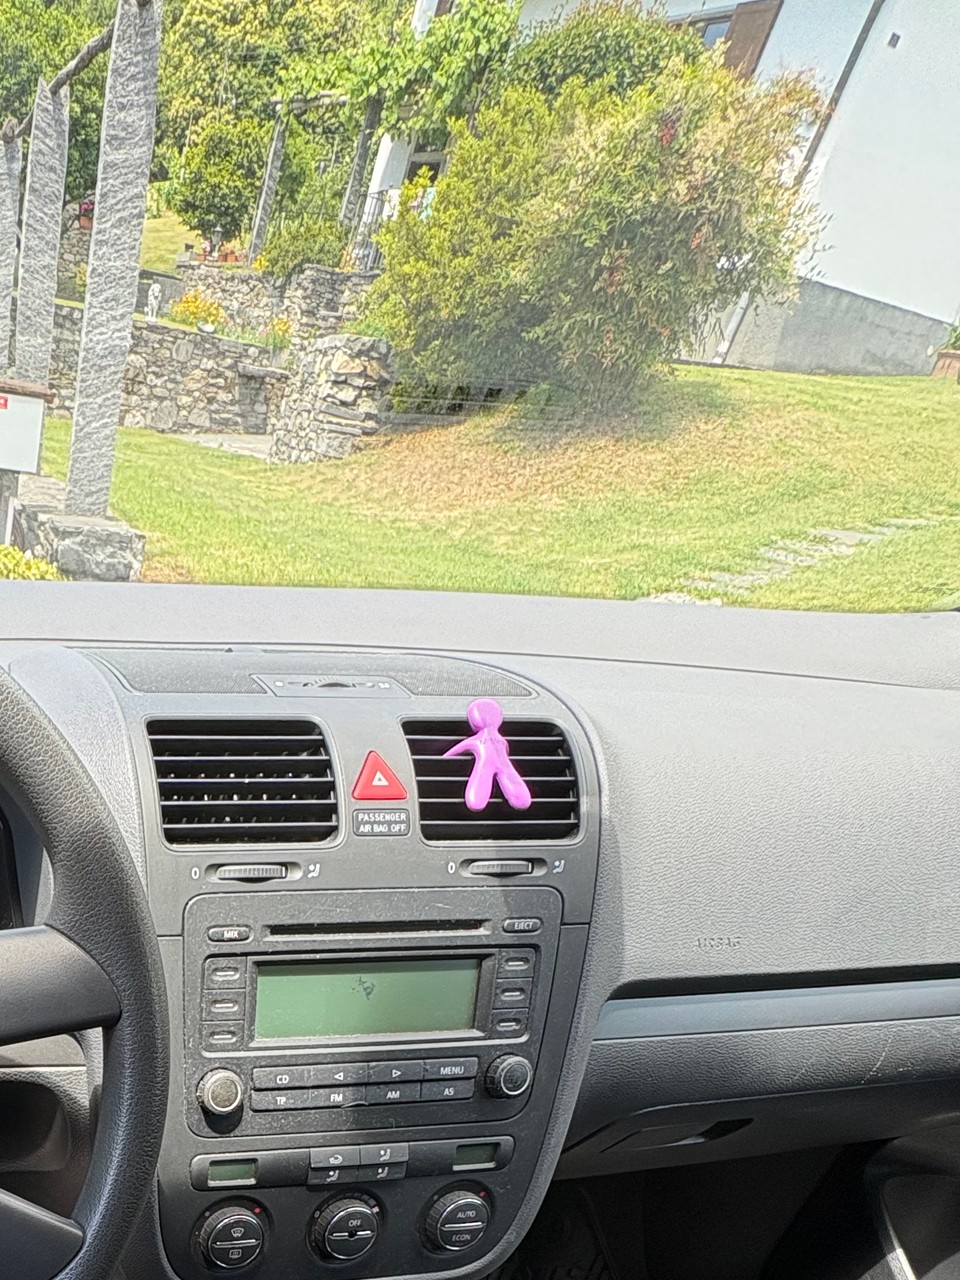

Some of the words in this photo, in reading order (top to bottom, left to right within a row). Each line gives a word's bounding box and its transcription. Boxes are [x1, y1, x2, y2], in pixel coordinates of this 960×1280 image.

[391, 824, 407, 833] OFF
[514, 921, 533, 930] EJECT
[224, 930, 239, 939] MIX
[440, 1065, 465, 1076] MENU
[276, 1074, 290, 1085] CD
[386, 1090, 401, 1100] AM
[443, 1086, 455, 1096] AS
[275, 1096, 287, 1106] TP
[330, 1092, 344, 1103] FM
[456, 1210, 476, 1218] AUTO
[348, 1219, 361, 1227] OFF
